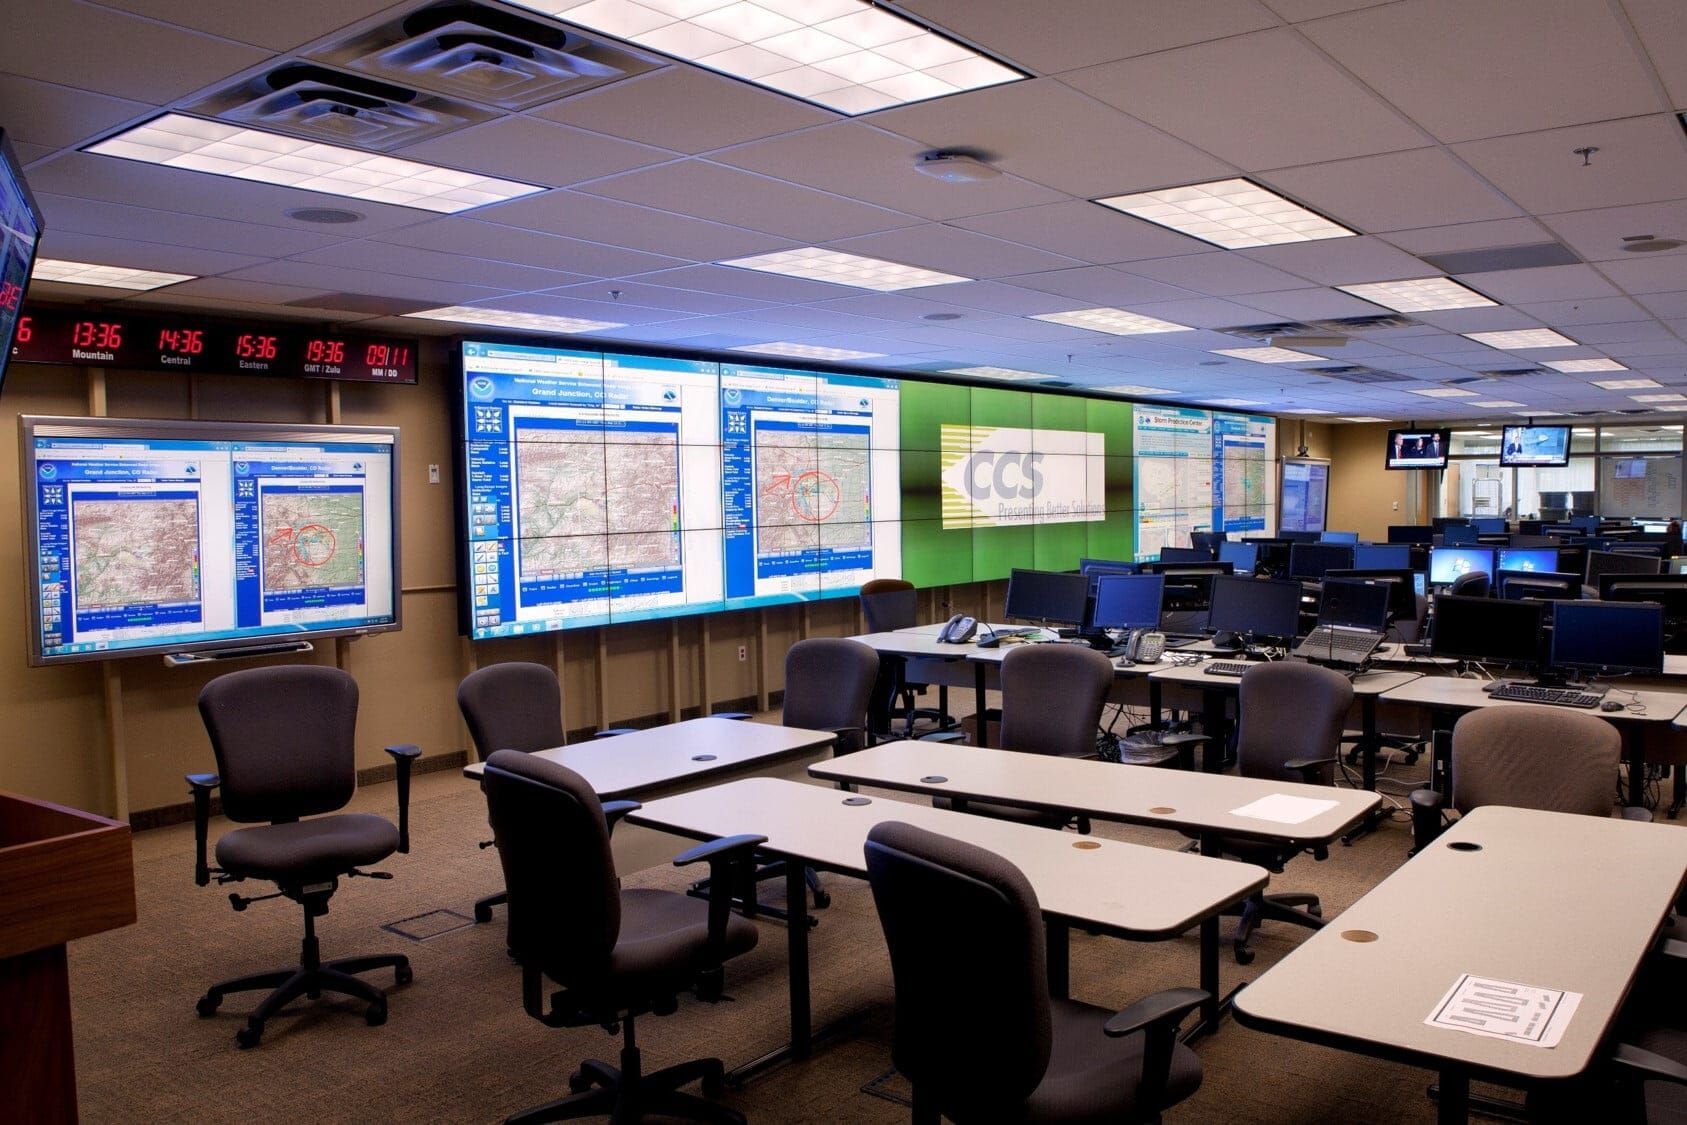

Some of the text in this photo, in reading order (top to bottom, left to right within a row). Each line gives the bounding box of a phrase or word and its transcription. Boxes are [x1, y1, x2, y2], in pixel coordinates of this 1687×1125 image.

[72, 321, 122, 349] 13:36
[158, 329, 204, 354] 14:36
[235, 335, 278, 359] 15:36
[72, 349, 114, 361] Mountain
[306, 340, 345, 363] 19:36
[160, 355, 191, 366] Central
[239, 360, 269, 370] Eastern
[304, 364, 320, 373] GMT
[325, 365, 341, 374] Zulu
[372, 368, 383, 376] MM
[531, 387, 556, 396] Grand
[558, 389, 593, 399] Junction,
[1153, 416, 1168, 424] Storm
[963, 449, 1045, 500] CCS
[998, 502, 1045, 524] Presenting
[1046, 500, 1070, 520] Better
